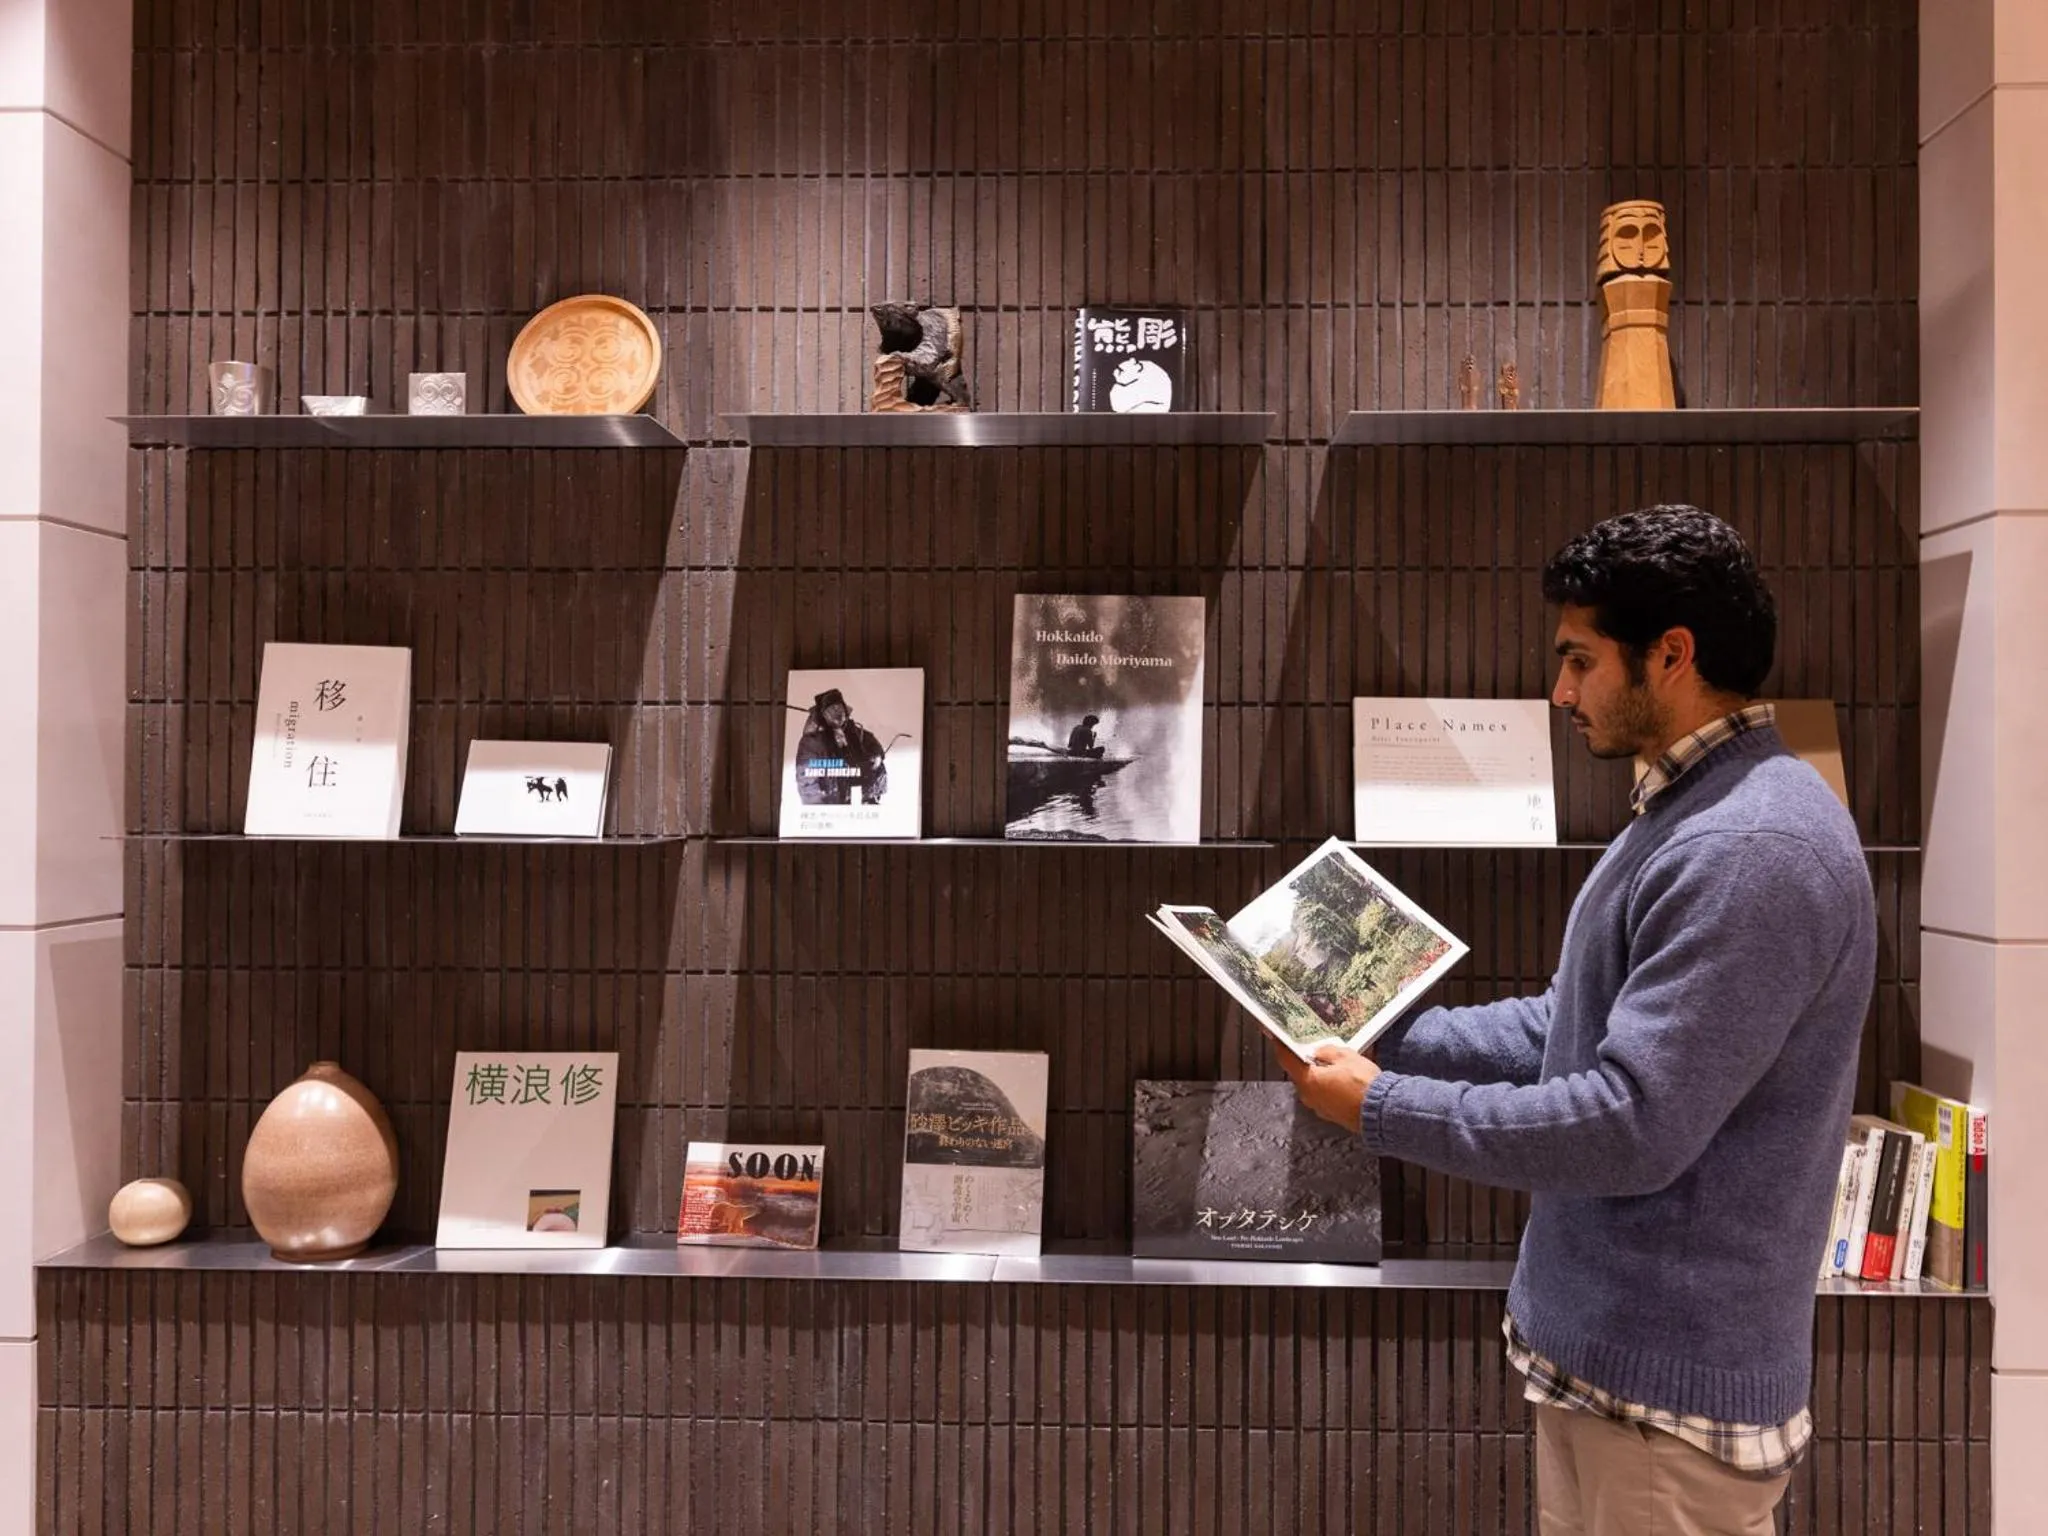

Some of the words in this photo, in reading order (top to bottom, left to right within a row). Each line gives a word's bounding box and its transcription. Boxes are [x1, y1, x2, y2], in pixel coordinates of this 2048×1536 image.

[1036, 630, 1103, 643] Hokkaido
[1056, 653, 1097, 666] Daido
[1099, 654, 1173, 668] Moriyama
[284, 701, 300, 768] migration
[1371, 718, 1427, 731] Place
[1443, 719, 1508, 732] Names
[465, 1062, 604, 1106] 横浪修
[728, 1151, 817, 1182] SOON
[1196, 1207, 1318, 1231] オプタテシケ
